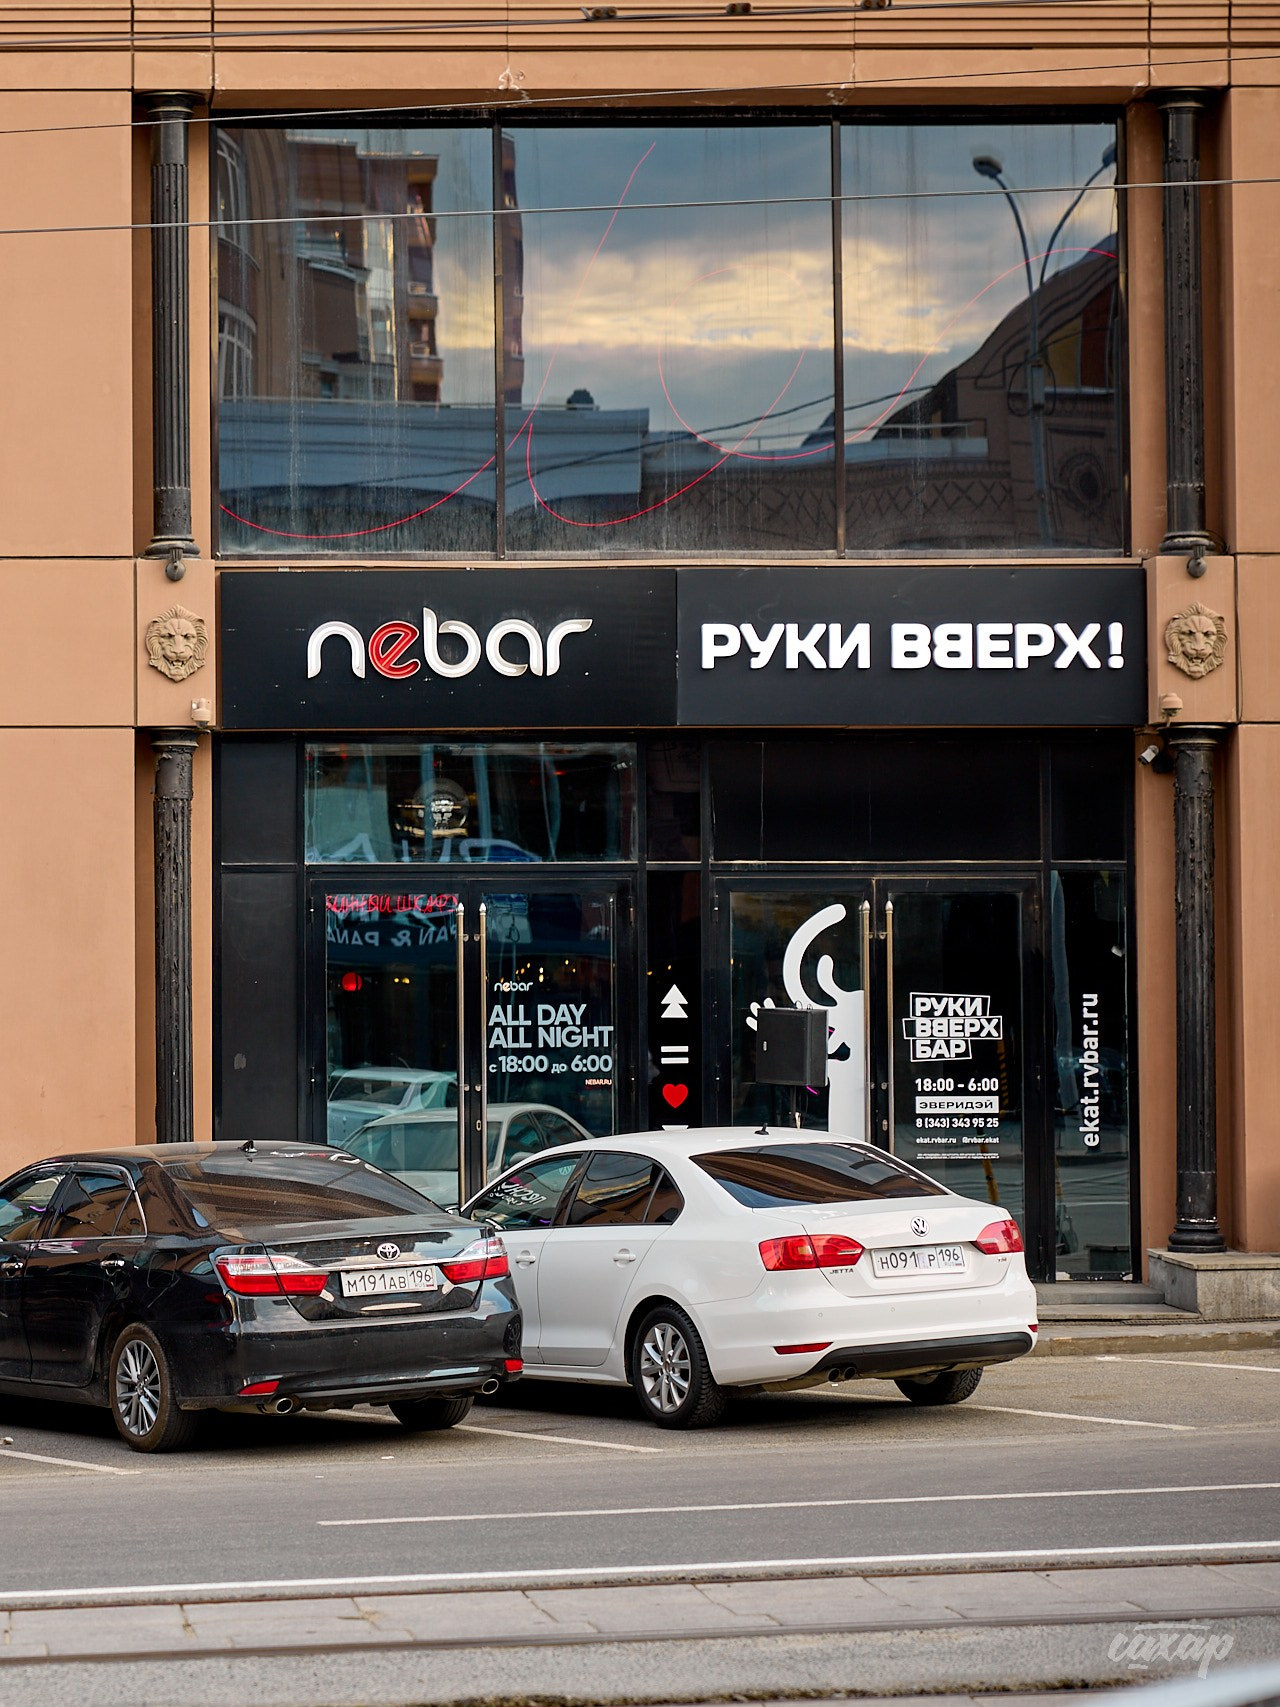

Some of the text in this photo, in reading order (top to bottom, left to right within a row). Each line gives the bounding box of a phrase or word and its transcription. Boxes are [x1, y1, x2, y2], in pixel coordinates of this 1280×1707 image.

[307, 607, 593, 679] nebar
[701, 623, 871, 669] РУКИ
[494, 981, 533, 992] nebar
[489, 1004, 587, 1026] ALL DAY
[915, 997, 982, 1017] РУКИ
[489, 1026, 614, 1048] ALL NIGHT
[915, 1039, 966, 1058] БАР
[498, 1055, 548, 1073] 18:00
[551, 1063, 567, 1074] до
[570, 1055, 613, 1073] 6:00
[1079, 993, 1100, 1147] ekat.rvbar.ru
[915, 1078, 955, 1092] 18:00
[967, 1078, 999, 1092] 6:00
[919, 1100, 994, 1110] ЭВЕРИДЭЙ
[915, 1118, 999, 1128] 8 (343) 343 95 25
[880, 1248, 960, 1269] Н091Р 196
[347, 1270, 432, 1293] М191АВ 196
